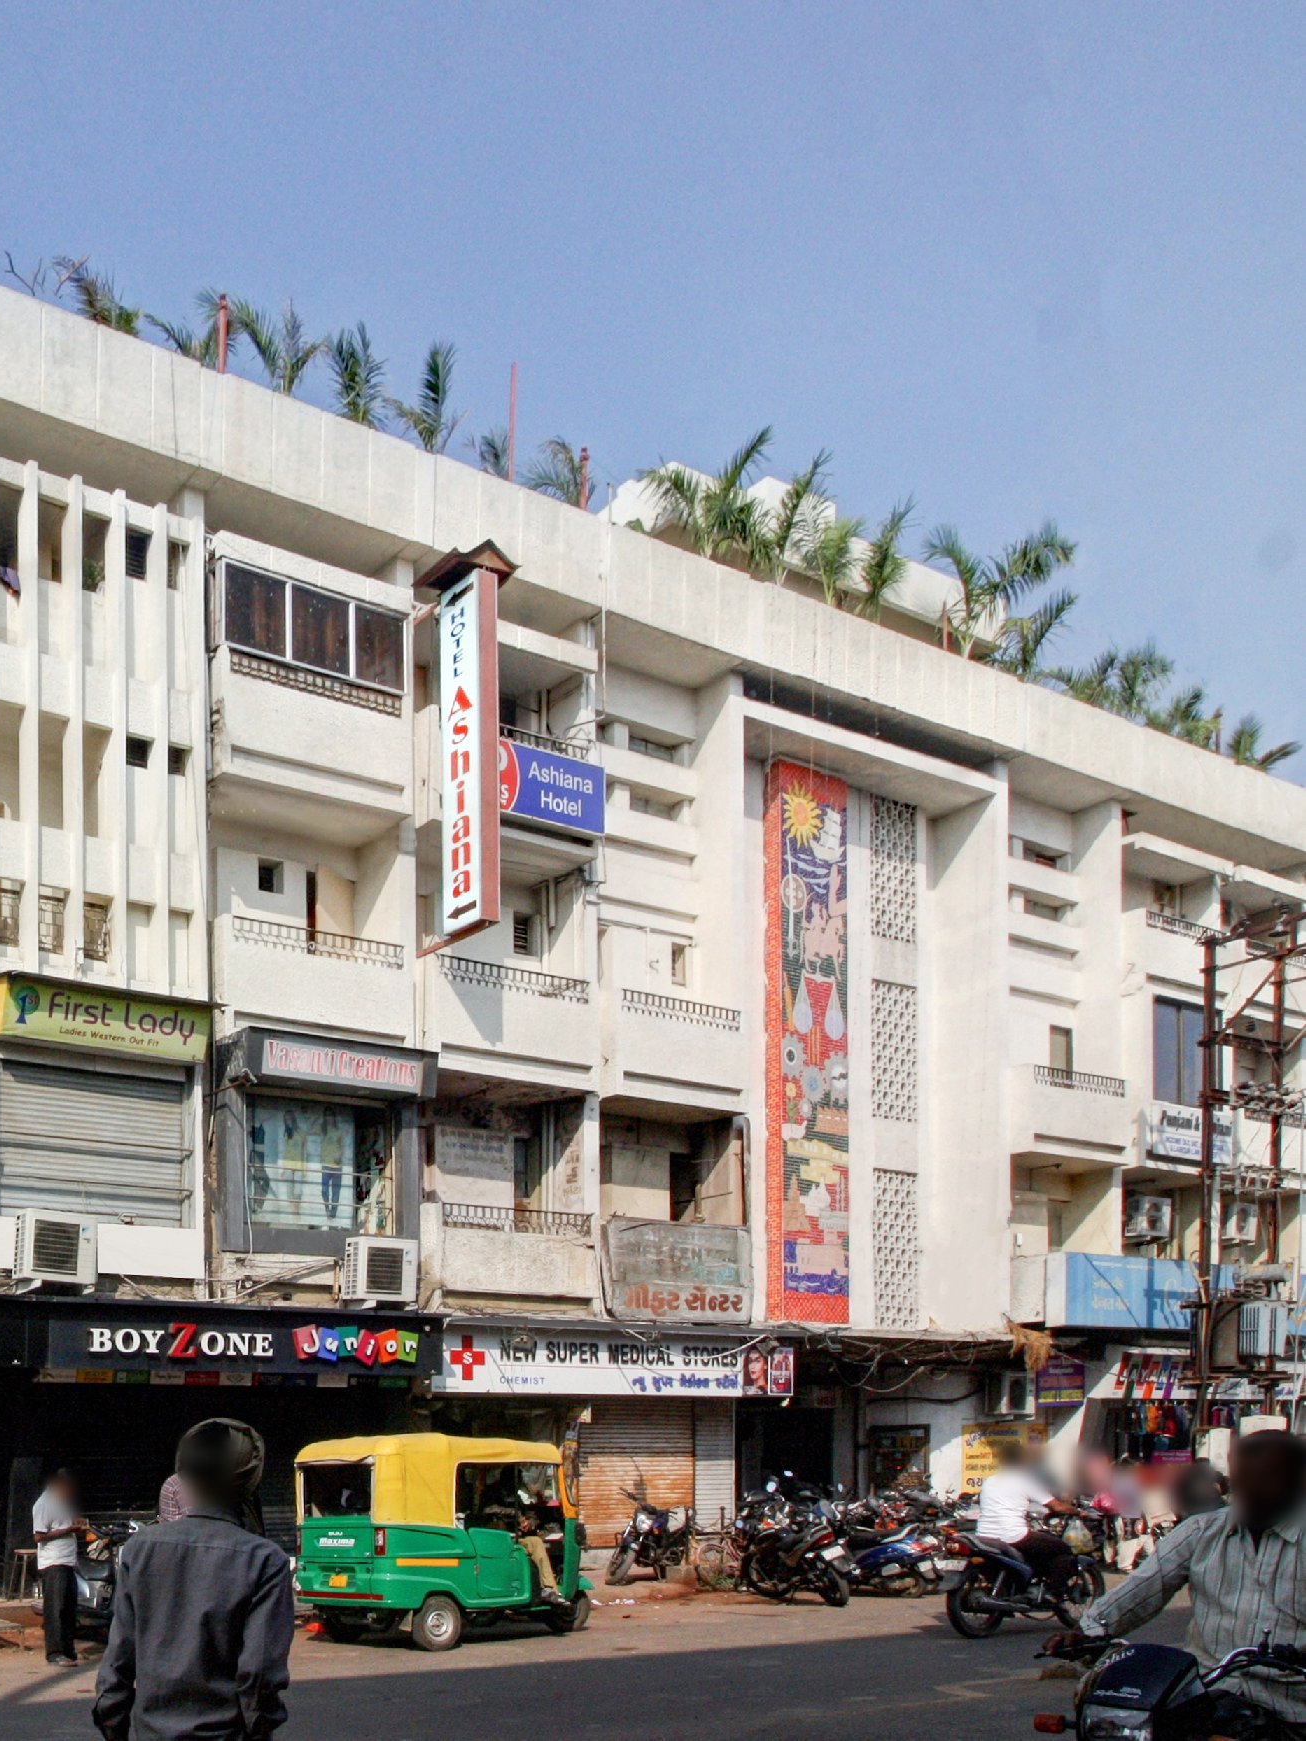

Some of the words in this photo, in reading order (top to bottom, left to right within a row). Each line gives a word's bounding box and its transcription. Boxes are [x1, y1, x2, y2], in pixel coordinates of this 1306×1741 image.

[450, 606, 467, 678] HOTEL
[527, 760, 594, 795] Ashiana
[540, 789, 583, 818] Hotel
[48, 990, 113, 1027] First
[59, 1026, 87, 1037] Ladies
[90, 1031, 126, 1042] Western
[129, 1036, 144, 1045] Out
[147, 1038, 160, 1047] Fit
[267, 1039, 336, 1076] Vasanti
[337, 1050, 418, 1087] Creations
[88, 1323, 274, 1358] BOYZONE
[301, 1329, 417, 1357] Junior
[545, 1340, 600, 1365] SUPER
[608, 1342, 676, 1366] MEDICAL
[682, 1345, 739, 1368] STORES
[462, 1351, 473, 1365] S
[499, 1375, 546, 1385] CHEMIST
